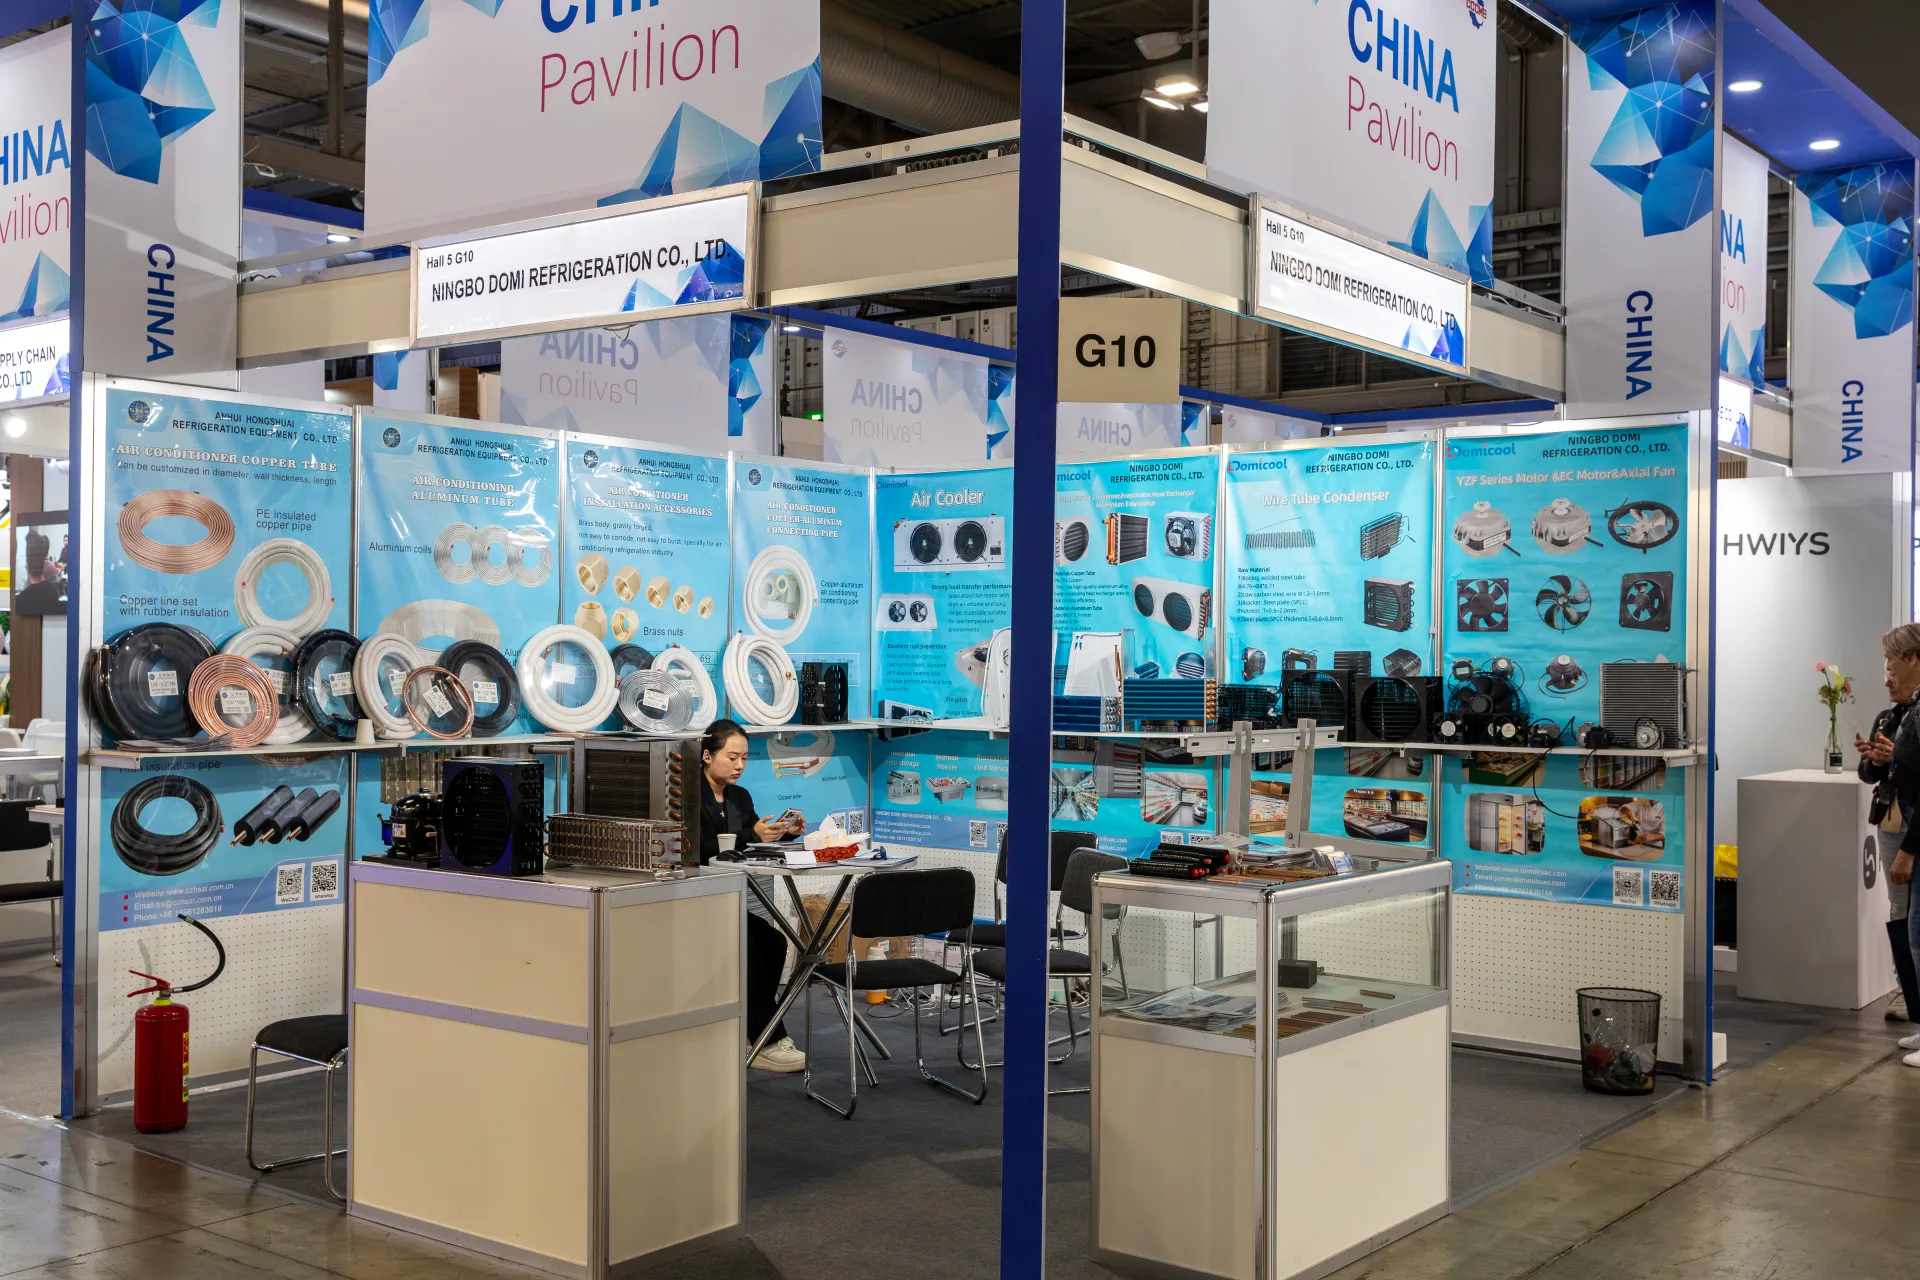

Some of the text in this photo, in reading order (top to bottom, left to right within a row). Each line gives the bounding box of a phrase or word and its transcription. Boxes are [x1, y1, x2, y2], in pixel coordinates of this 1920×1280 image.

[1348, 0, 1459, 114] CHINA
[541, 24, 739, 112] Pavilion
[1348, 75, 1458, 181] Pavilion
[1266, 219, 1305, 244] Hall 5 G10
[427, 250, 474, 270] Hall 5 G10
[432, 237, 731, 303] NINGBO DOMI REFRIGERATION CO., LTD.
[1270, 250, 1312, 283] NINGBO
[1316, 266, 1341, 293] DOMI
[1344, 276, 1418, 320] REFRIGERATION
[147, 243, 175, 363] CHINA
[1075, 333, 1157, 368] G10
[1625, 290, 1653, 400] CHINA
[26, 346, 56, 364] CHAIN
[215, 412, 295, 428] ANHUI HONGSHUAI
[1841, 379, 1864, 463] CHINA
[172, 419, 298, 440] REFRIGERATION EQUIPMENT
[450, 437, 514, 451] ANHUI HONGSHUAI
[1568, 433, 1641, 446] NINGBO DOMI
[116, 444, 338, 472] AIR CONDITIONER COPPER TUBE
[417, 444, 475, 458] REFRIGERATION
[1328, 451, 1390, 462] NINGBO DOMI
[1447, 443, 1516, 458] Domicool
[1542, 443, 1670, 459] REFRIGERATION CO., LTD.
[639, 458, 691, 470] ANHUI HONGSHUAI
[1130, 463, 1183, 473] NINGBO DOMI
[1227, 458, 1288, 472] Domicool
[1306, 462, 1374, 474] REFRIGERATION
[1396, 460, 1414, 469] LTD.
[116, 460, 134, 470] Can
[137, 461, 148, 471] be
[150, 463, 200, 476] customized
[202, 468, 210, 476] in
[254, 472, 270, 481] wall
[313, 476, 337, 487] length
[1110, 473, 1169, 483] REFRIGERATION
[1189, 472, 1205, 480] LTD.
[1456, 466, 1676, 486] YZF Series Motor &EC Motor&Axial Fan
[412, 475, 515, 493] AIR CONDITIONING
[773, 482, 842, 495] REFRIGERATION EQUIPMENT
[411, 490, 515, 507] ALUMINUM TUBE
[608, 486, 689, 501] AIR CONDITIONER
[910, 488, 985, 508] Air Cooler
[1261, 490, 1390, 506] Wire Tube Condenser
[256, 508, 317, 522] PE insulated
[583, 498, 713, 517] INSTALLATION ACCESSORIES
[767, 501, 836, 514] AIR CONDITIONER
[256, 520, 312, 532] copper pipe
[578, 519, 632, 530] Brass gravity
[767, 513, 843, 527] COPPER-ALUMINUM
[767, 525, 839, 538] CONNECTING PIPE
[369, 542, 432, 554] Aluminum coils
[578, 545, 614, 554] conditioning
[615, 546, 651, 555] refrigeration
[1723, 531, 1831, 556] HWIYS
[119, 595, 198, 608] Copper line set
[119, 605, 229, 618] with rubber insulation
[643, 627, 684, 636] Brass nuts
[146, 761, 195, 772] insulation
[198, 760, 220, 772] pipe
